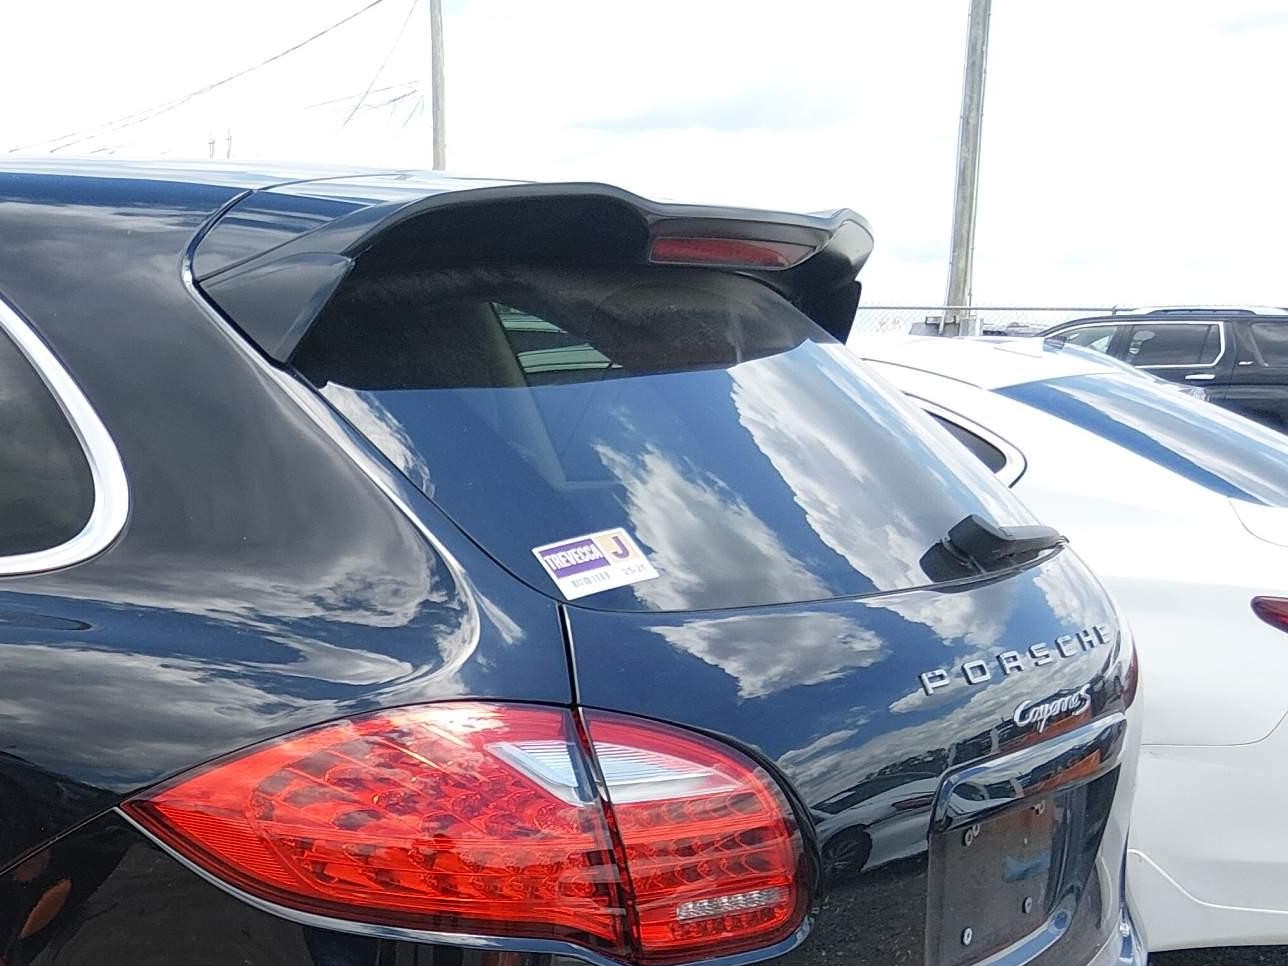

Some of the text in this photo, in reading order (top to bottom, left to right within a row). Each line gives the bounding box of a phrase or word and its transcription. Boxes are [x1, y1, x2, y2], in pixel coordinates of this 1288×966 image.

[543, 543, 604, 571] TREVECCA
[611, 535, 630, 559] J
[918, 623, 1112, 697] PORSCHE
